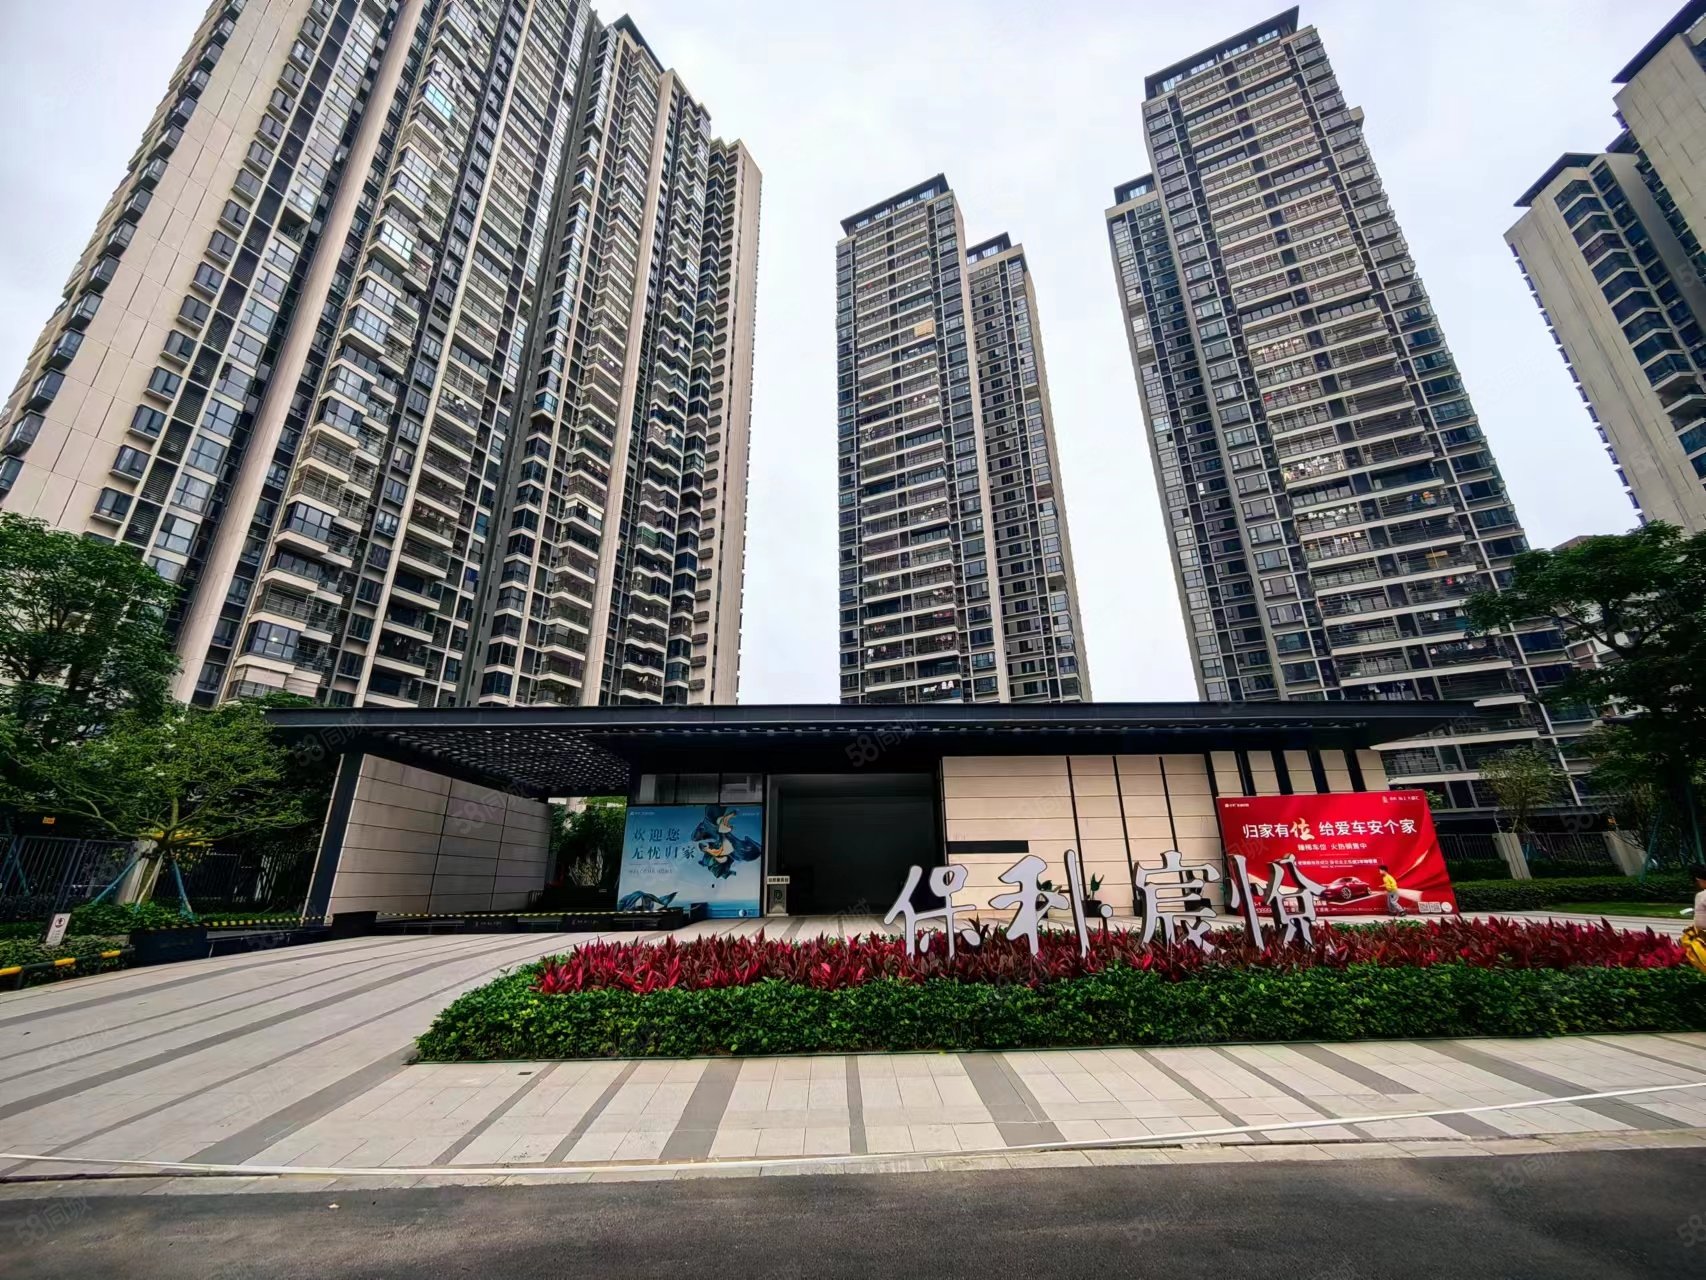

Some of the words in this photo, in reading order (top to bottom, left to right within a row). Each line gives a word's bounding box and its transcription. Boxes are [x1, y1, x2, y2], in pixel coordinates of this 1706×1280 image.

[632, 828, 680, 842] 欢迎您
[1243, 818, 1316, 841] 归家有位
[1319, 818, 1417, 837] 给爱车安个家
[632, 846, 696, 860] 无忧归家
